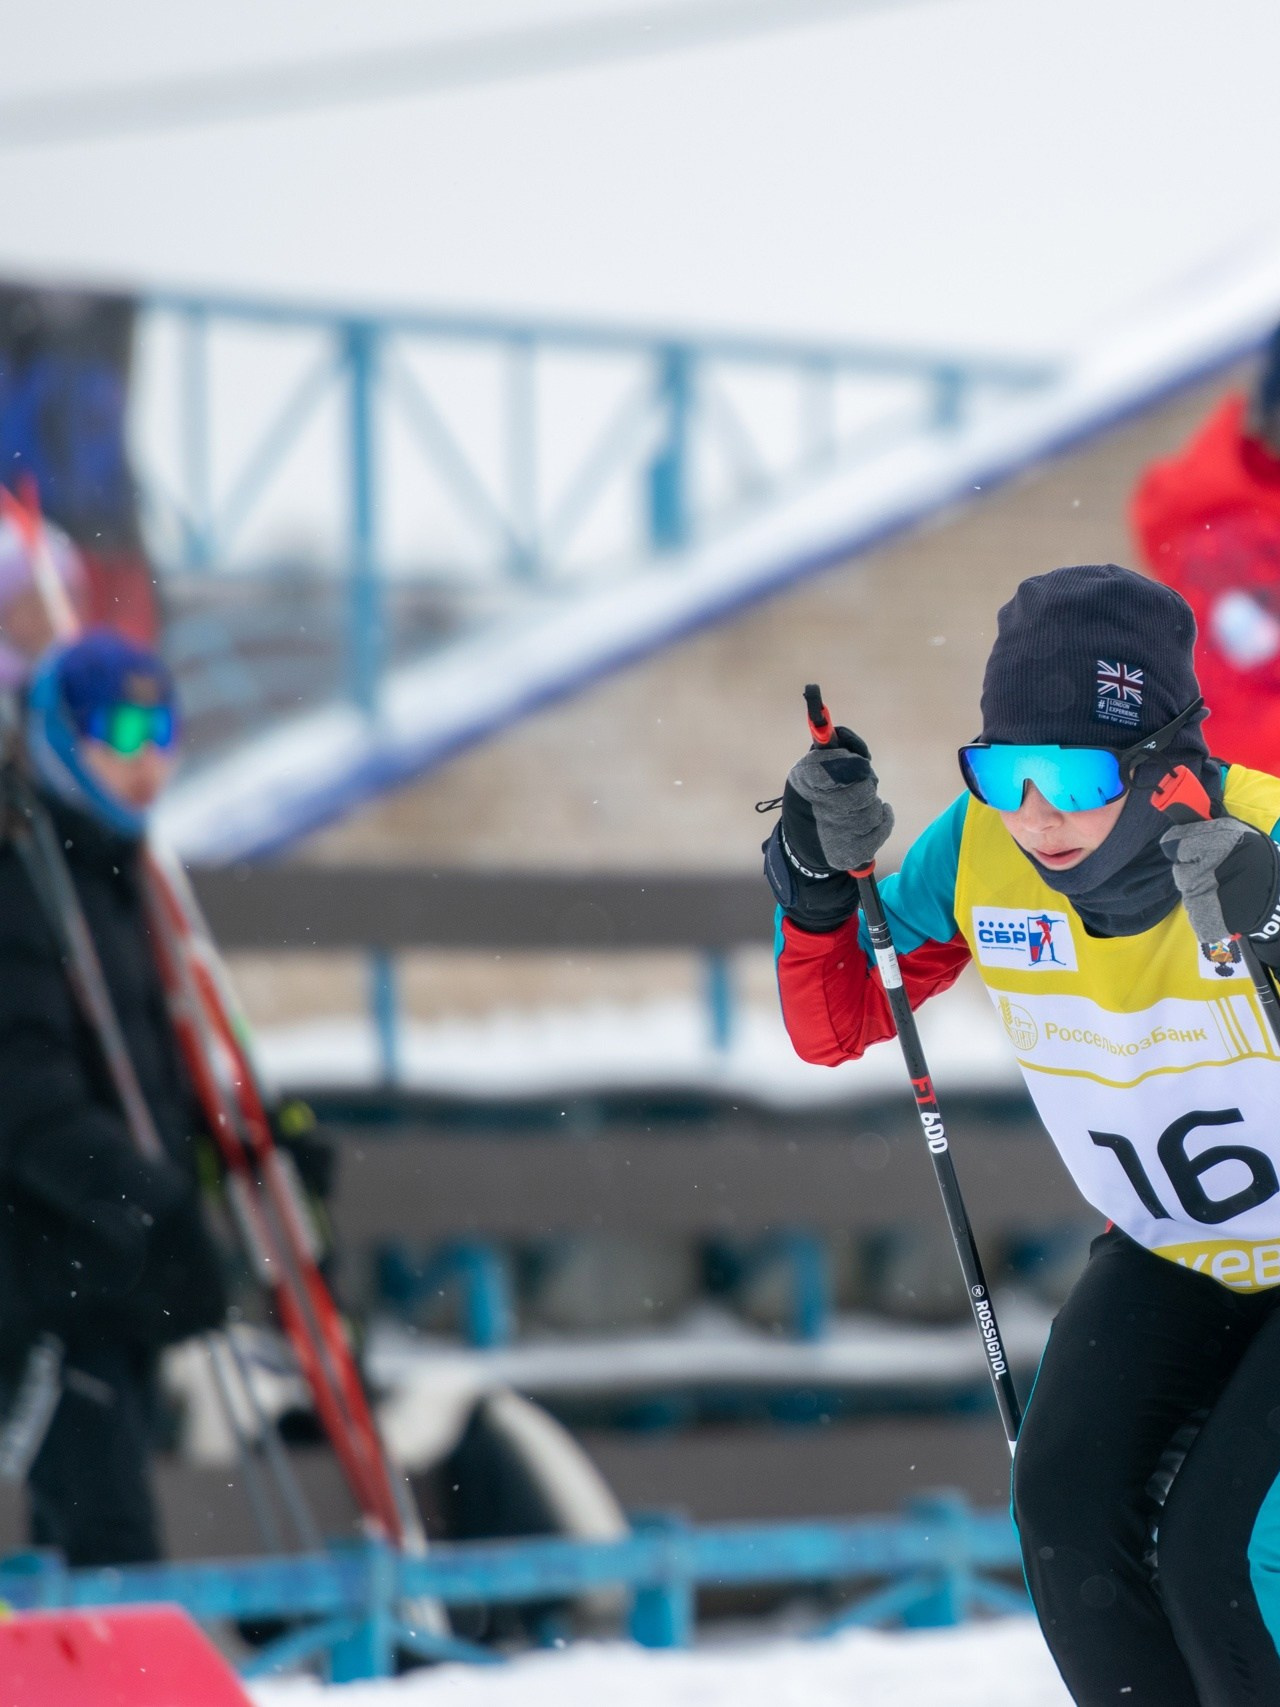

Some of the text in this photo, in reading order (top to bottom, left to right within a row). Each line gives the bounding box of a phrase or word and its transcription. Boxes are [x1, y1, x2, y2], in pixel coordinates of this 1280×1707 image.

[1110, 700, 1130, 709] LONDON
[979, 929, 1026, 944] СБР
[1087, 1107, 1280, 1225] 16
[976, 1299, 1007, 1380] ROSSIGNOL
